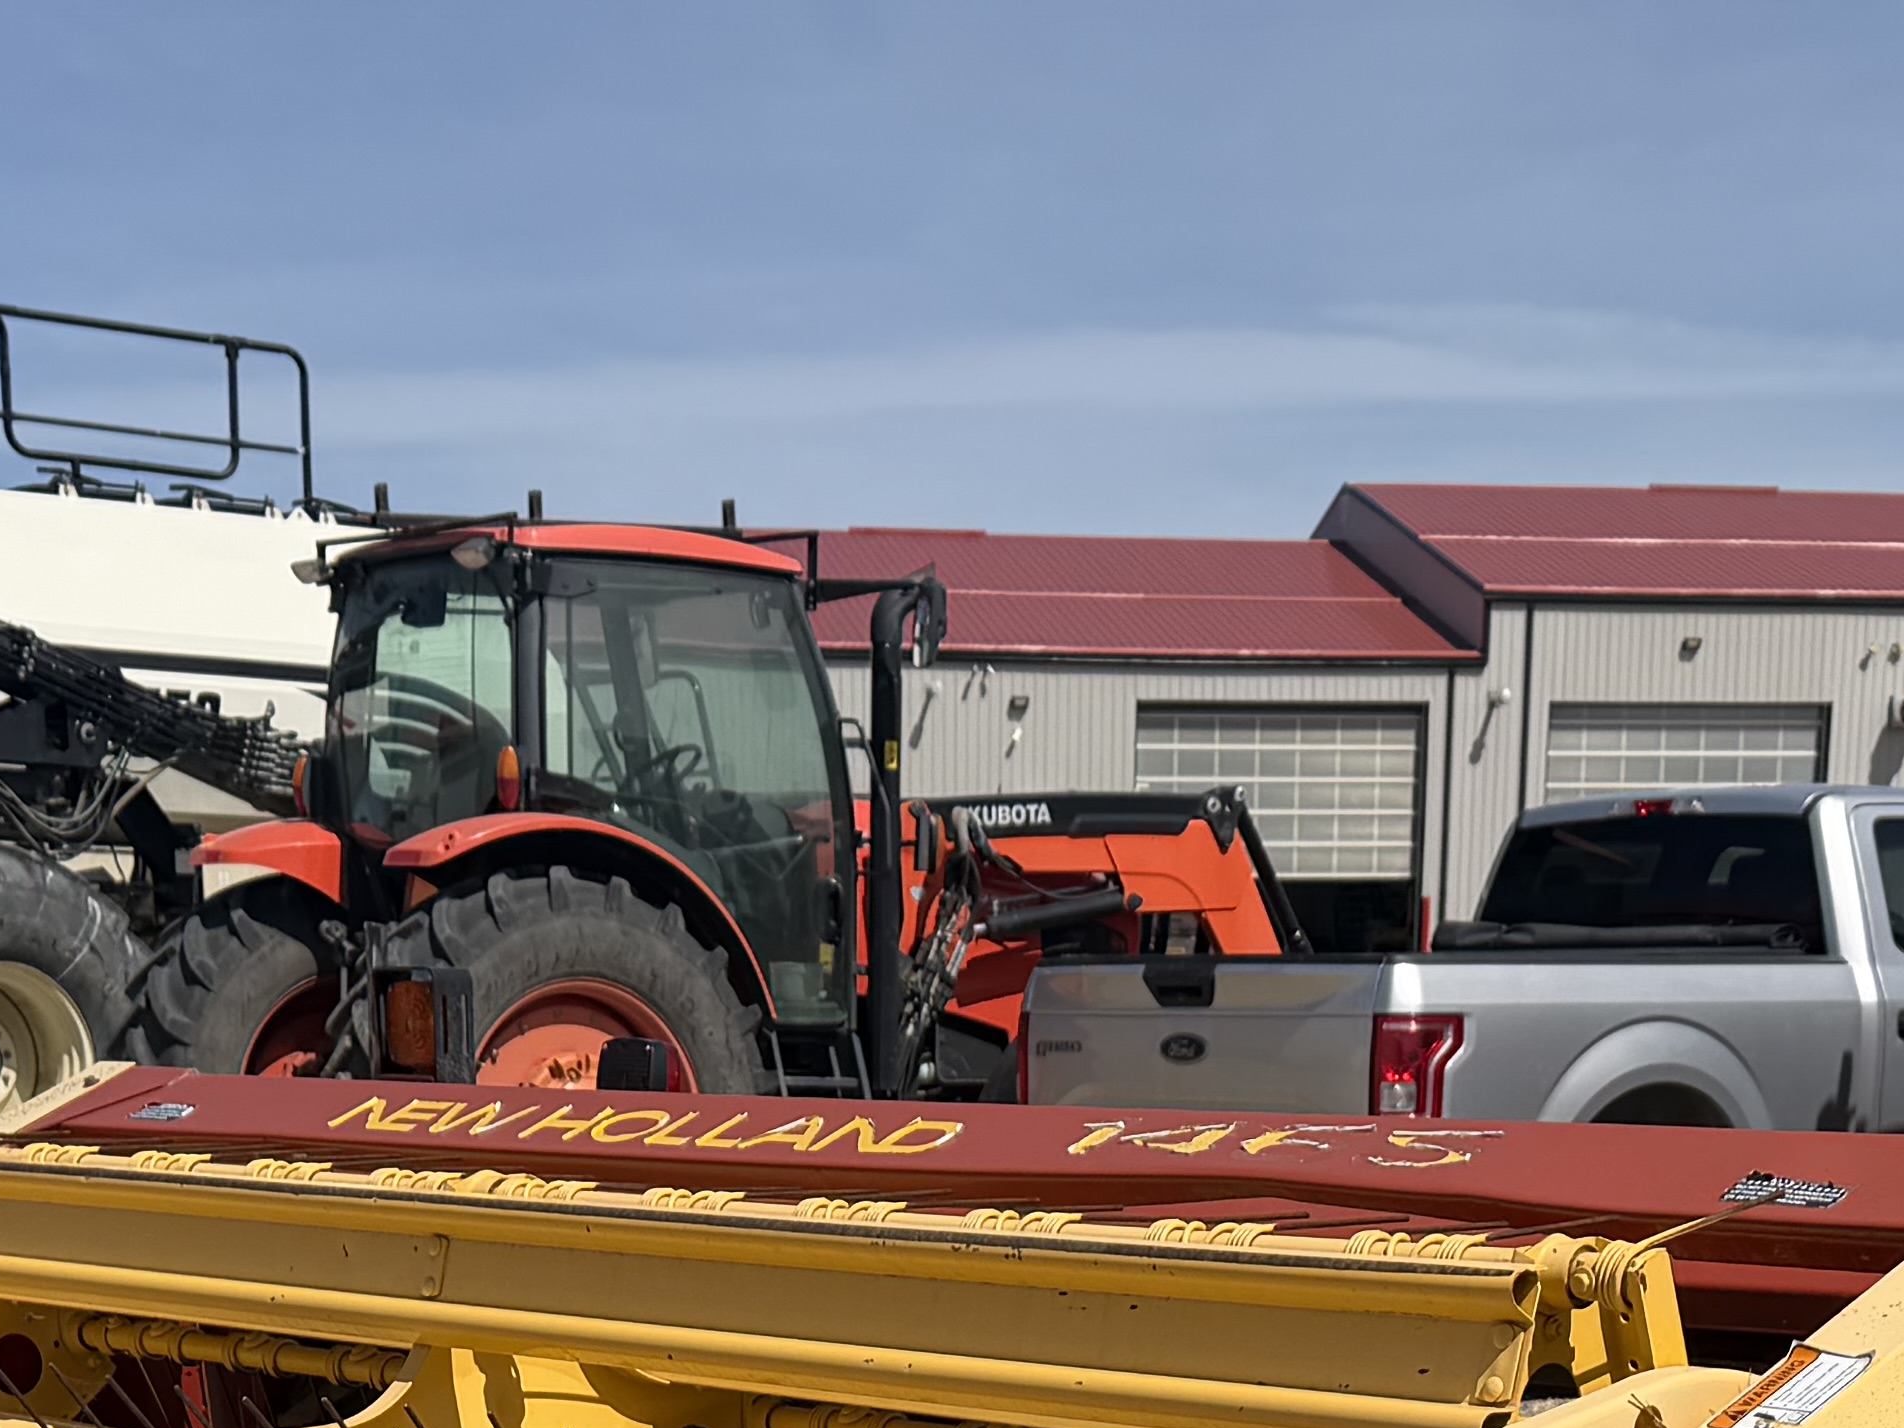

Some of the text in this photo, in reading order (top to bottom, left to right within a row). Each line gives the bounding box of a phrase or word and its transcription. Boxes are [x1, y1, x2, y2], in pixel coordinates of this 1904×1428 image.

[968, 803, 1051, 826] KUBOTA
[328, 1096, 541, 1135] NEW
[518, 1103, 964, 1154] HOLLAND
[1741, 1359, 1805, 1408] WARNING
